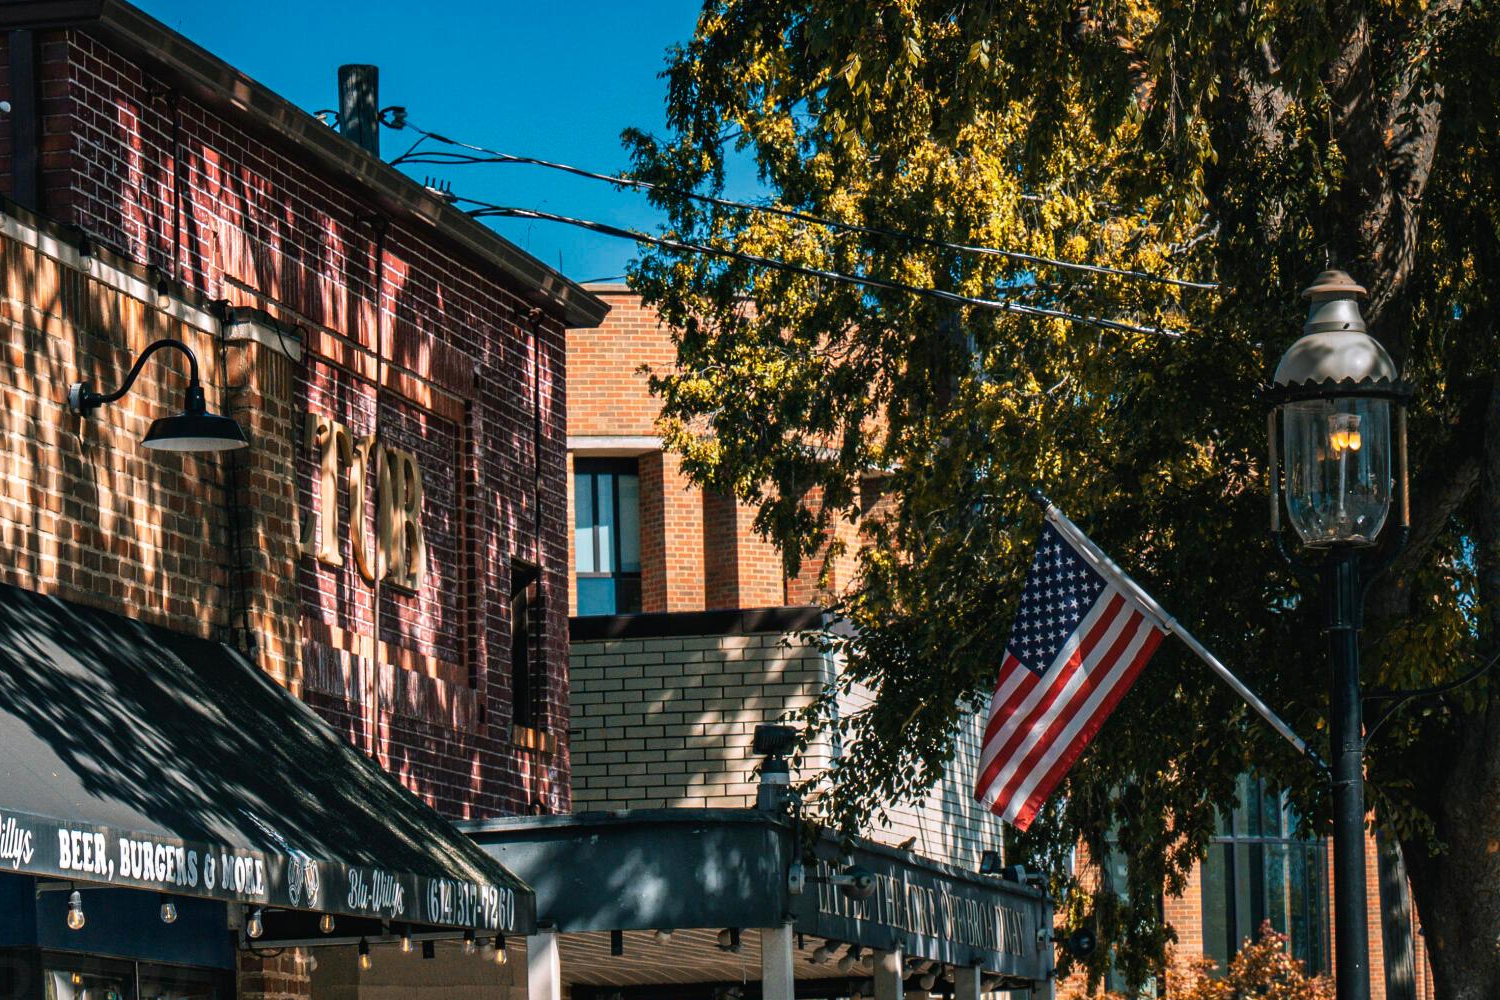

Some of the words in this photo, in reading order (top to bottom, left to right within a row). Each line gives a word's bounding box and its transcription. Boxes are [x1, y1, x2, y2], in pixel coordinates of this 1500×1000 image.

[300, 413, 426, 591] TOB
[58, 828, 114, 881] BEER,
[119, 838, 198, 888] BURGERS
[203, 853, 216, 890] &
[221, 853, 264, 896] MORE
[348, 868, 405, 919] Blu-Willys
[426, 877, 515, 932] (614)317-7260
[874, 872, 939, 938] THEATRE
[940, 886, 963, 944] OFF
[965, 898, 1024, 957] BROADWAY
